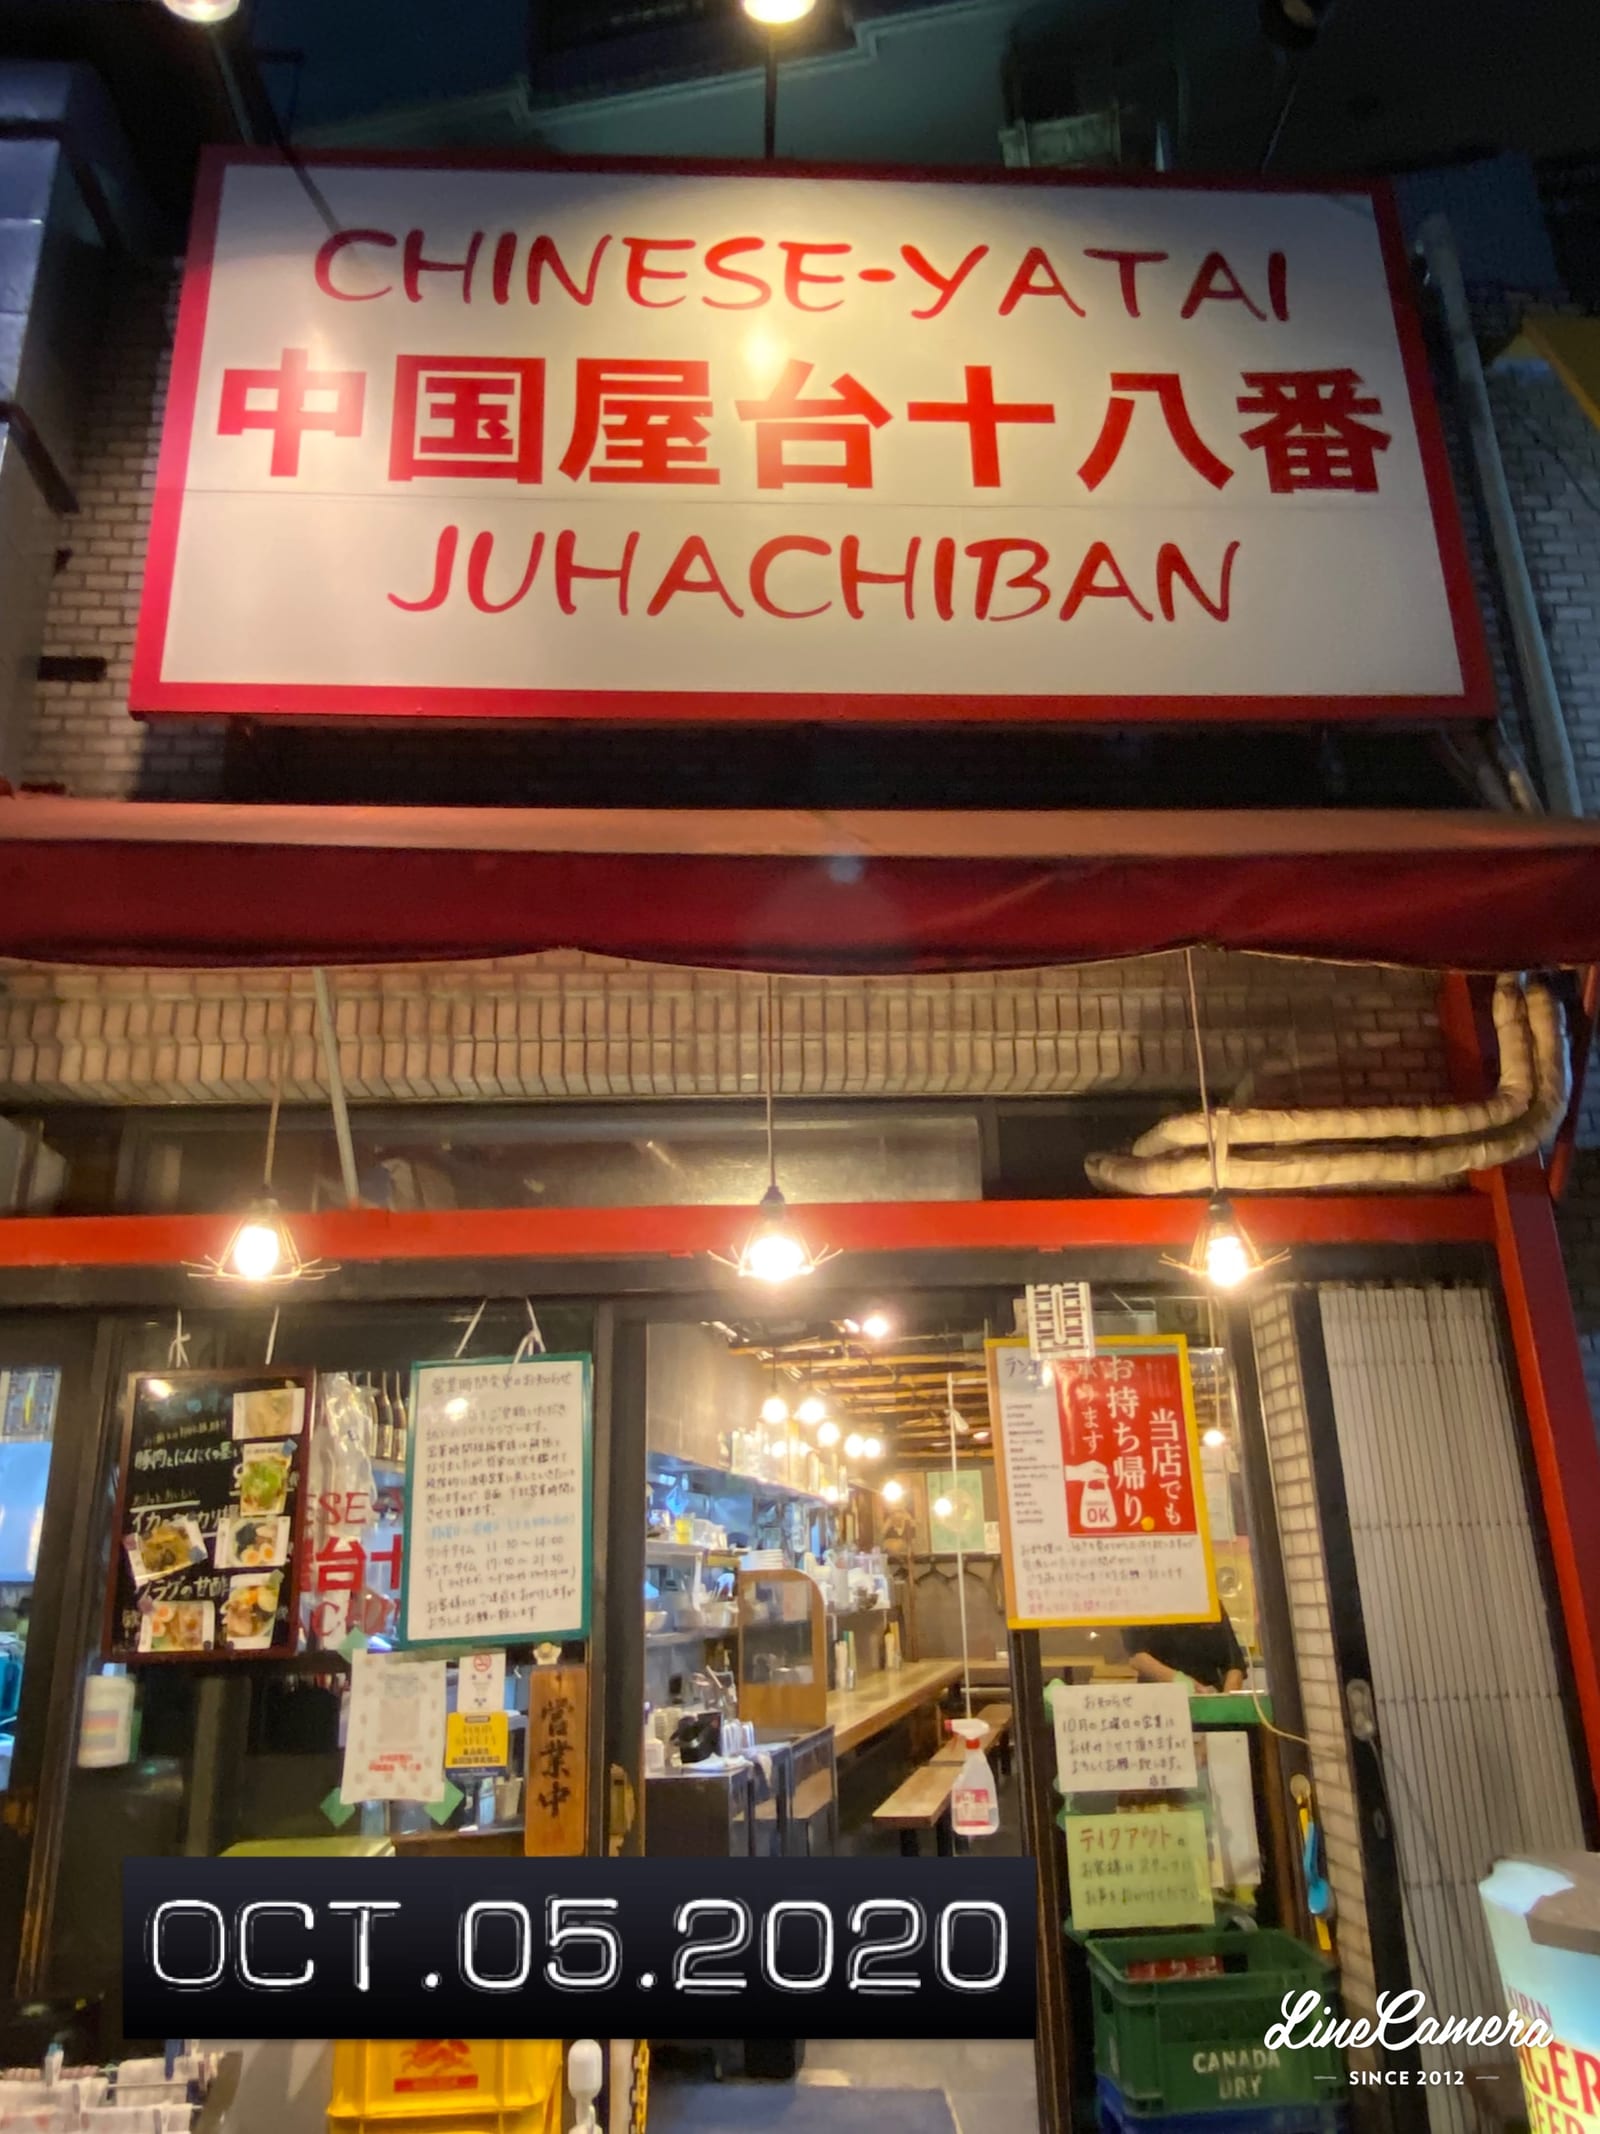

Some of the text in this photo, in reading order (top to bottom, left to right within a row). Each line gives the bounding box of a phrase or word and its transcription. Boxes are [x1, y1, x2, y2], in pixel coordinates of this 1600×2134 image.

[315, 229, 1289, 322] CHINESE-YATAI
[217, 347, 1391, 495] 中国屋台十八番
[388, 524, 1241, 623] JUHACHIBAN
[1086, 1507, 1111, 1523] OK
[1149, 1407, 1182, 1526] 当店でも
[538, 1697, 575, 1819] 営業中
[1192, 2049, 1282, 2074] CANADA
